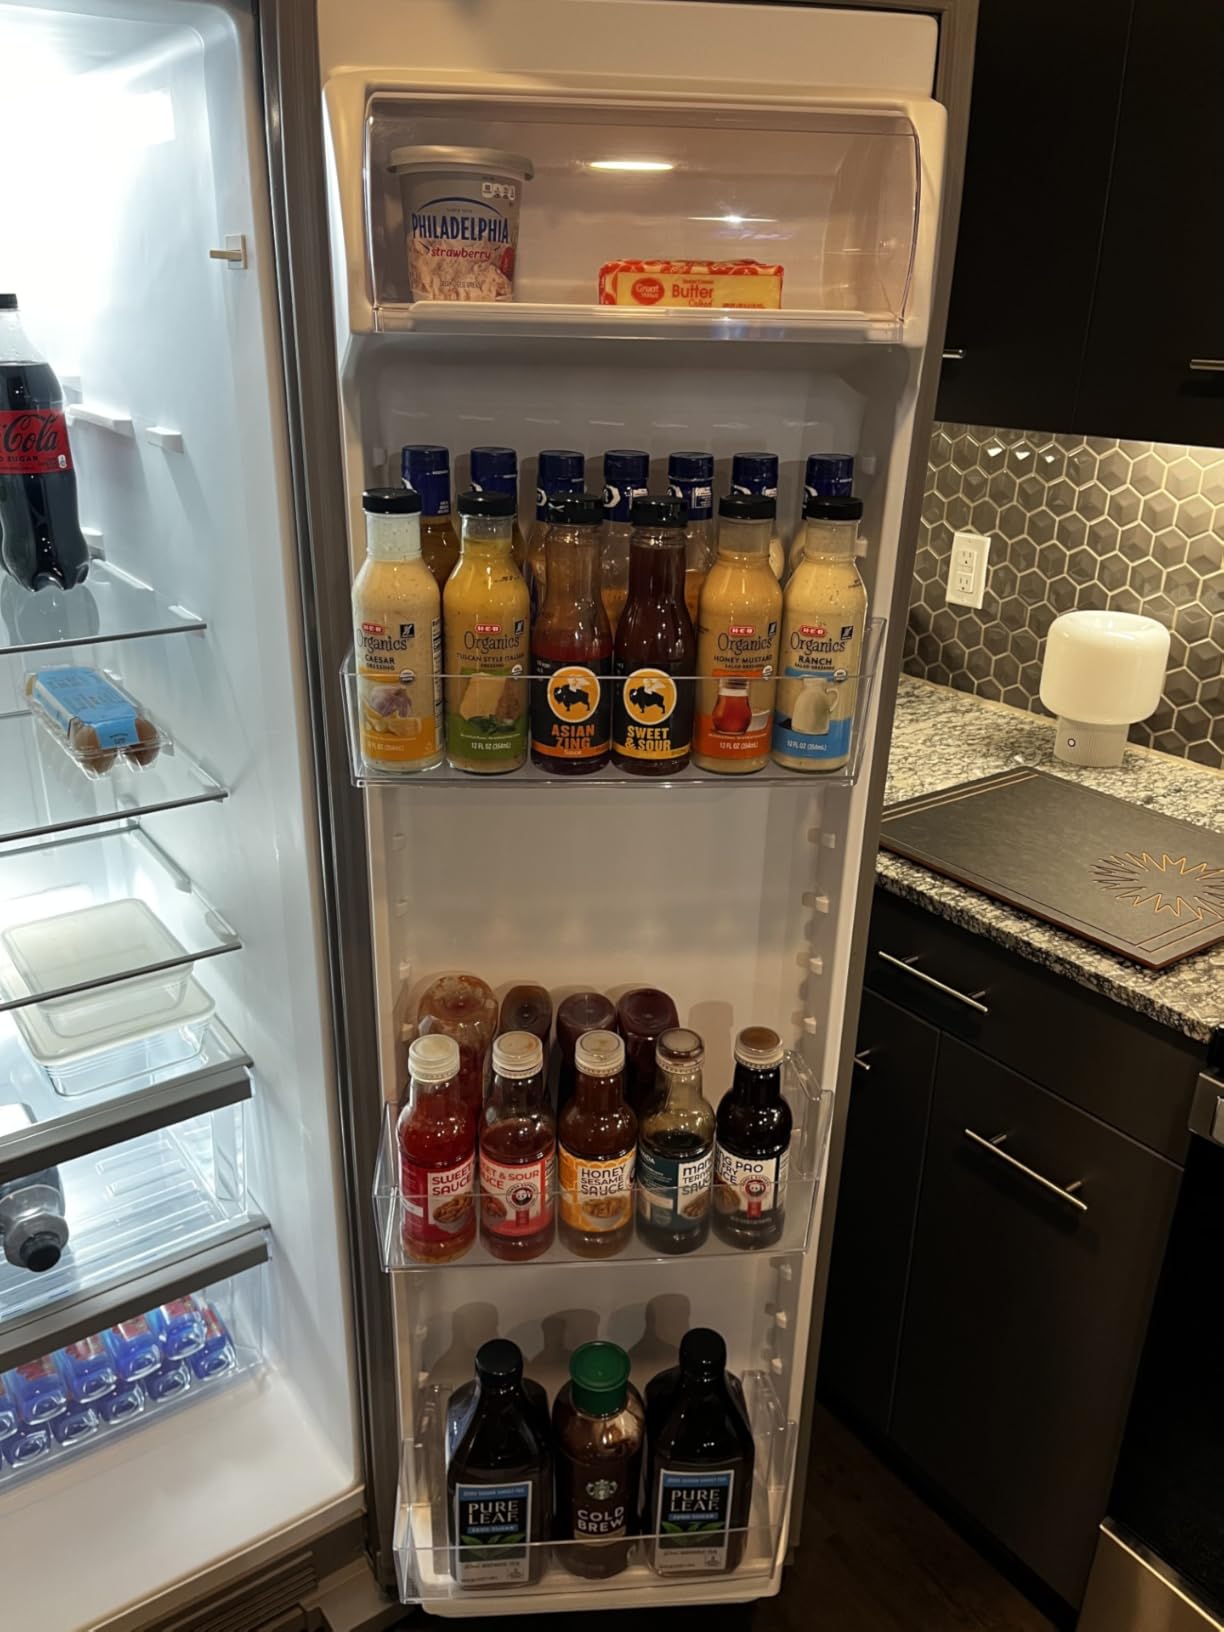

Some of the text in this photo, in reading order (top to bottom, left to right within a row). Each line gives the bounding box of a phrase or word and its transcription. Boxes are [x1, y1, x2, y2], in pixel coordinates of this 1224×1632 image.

[411, 213, 509, 243] PHILADELPHIA
[431, 246, 491, 259] strawberry
[671, 284, 713, 299] Butter
[357, 629, 407, 654] Organics
[464, 631, 520, 654] Organics
[718, 633, 772, 656] Organics
[791, 631, 846, 656] Organics
[365, 654, 395, 665] CAESAR
[713, 655, 740, 663] HONEY
[799, 655, 832, 666] RANCH
[551, 724, 595, 737] ASIAN
[627, 725, 670, 740] SWEET
[556, 737, 591, 750] ZING
[625, 737, 671, 751] & SOUR
[581, 1164, 626, 1179] HONEY
[735, 1160, 764, 1174] PAO
[432, 1164, 473, 1186] SWEET
[508, 1169, 540, 1181] SOUR
[581, 1175, 624, 1186] SESAME
[432, 1173, 472, 1197] SAUCE
[581, 1181, 625, 1197] SAUCE
[671, 1489, 721, 1501] PURE
[468, 1500, 519, 1514] PURE
[670, 1500, 720, 1512] LEAF
[468, 1511, 519, 1525] LEAF
[577, 1506, 625, 1522] COLD
[577, 1515, 625, 1532] BREW
